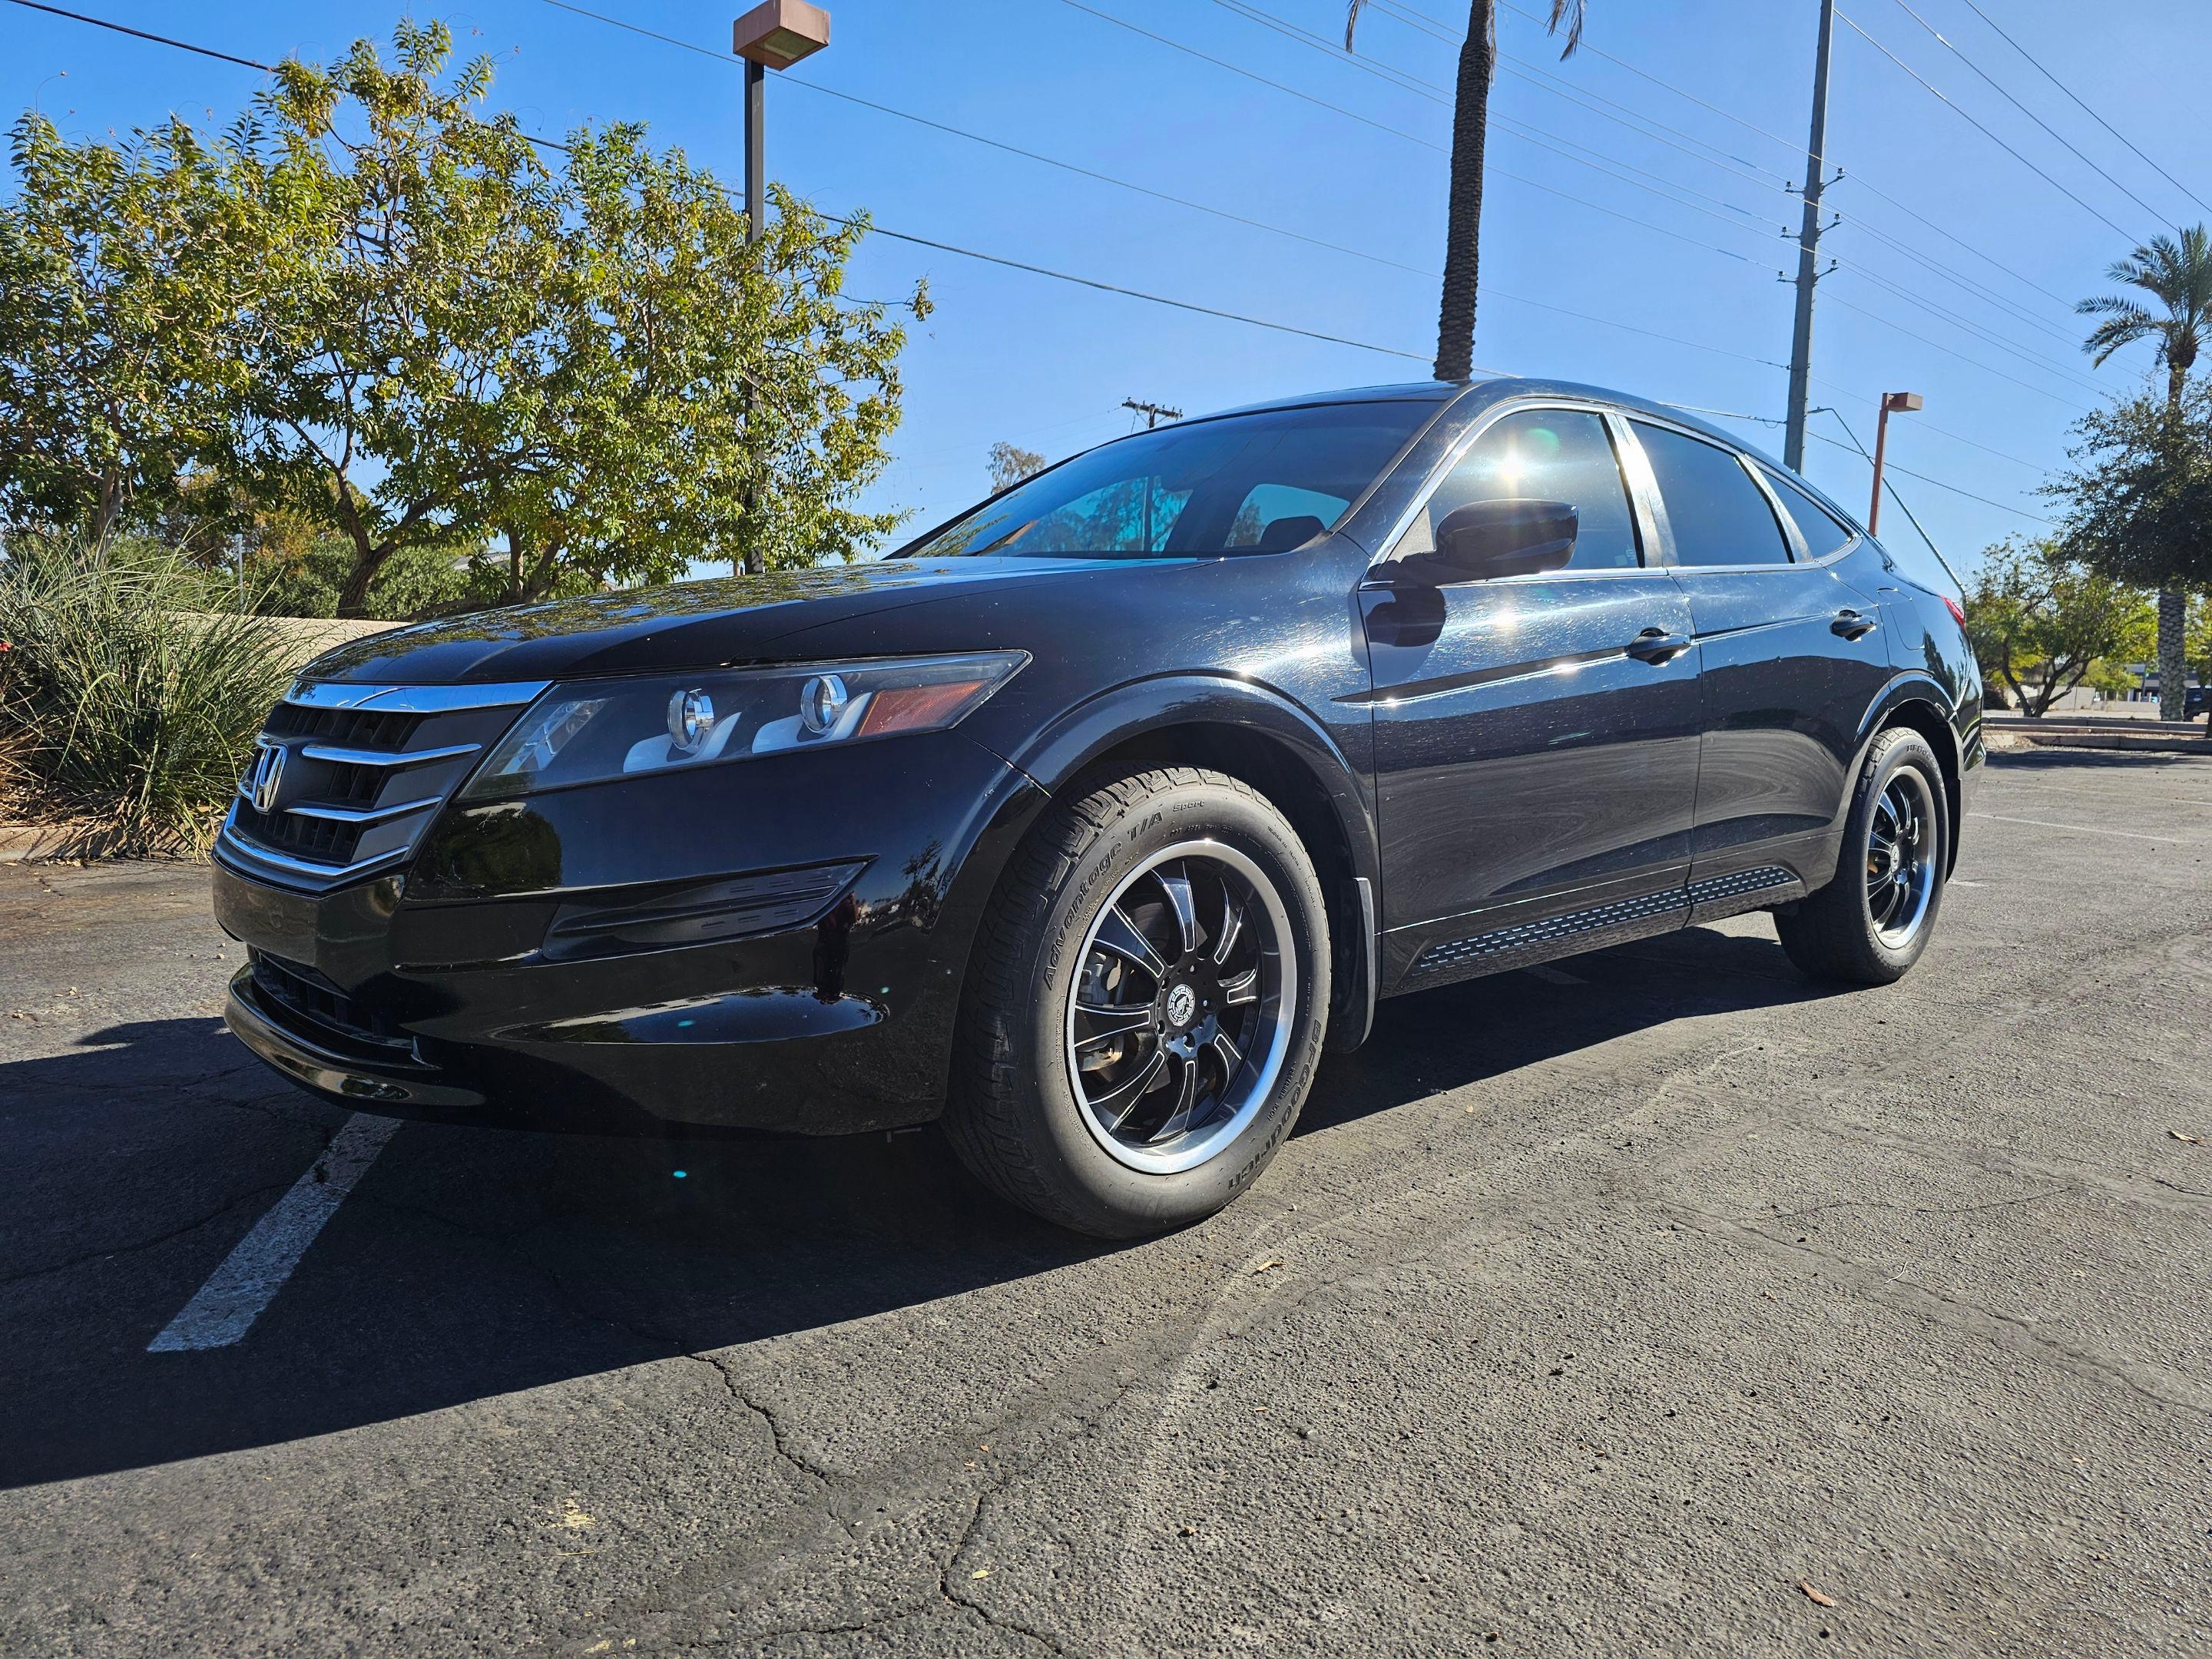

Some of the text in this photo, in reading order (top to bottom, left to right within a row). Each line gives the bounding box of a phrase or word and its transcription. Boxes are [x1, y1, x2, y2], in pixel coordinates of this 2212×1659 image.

[1042, 842, 1123, 991] Advantage
[1173, 800, 1205, 813] Sport
[1229, 1019, 1321, 1190] BFGoodrich
